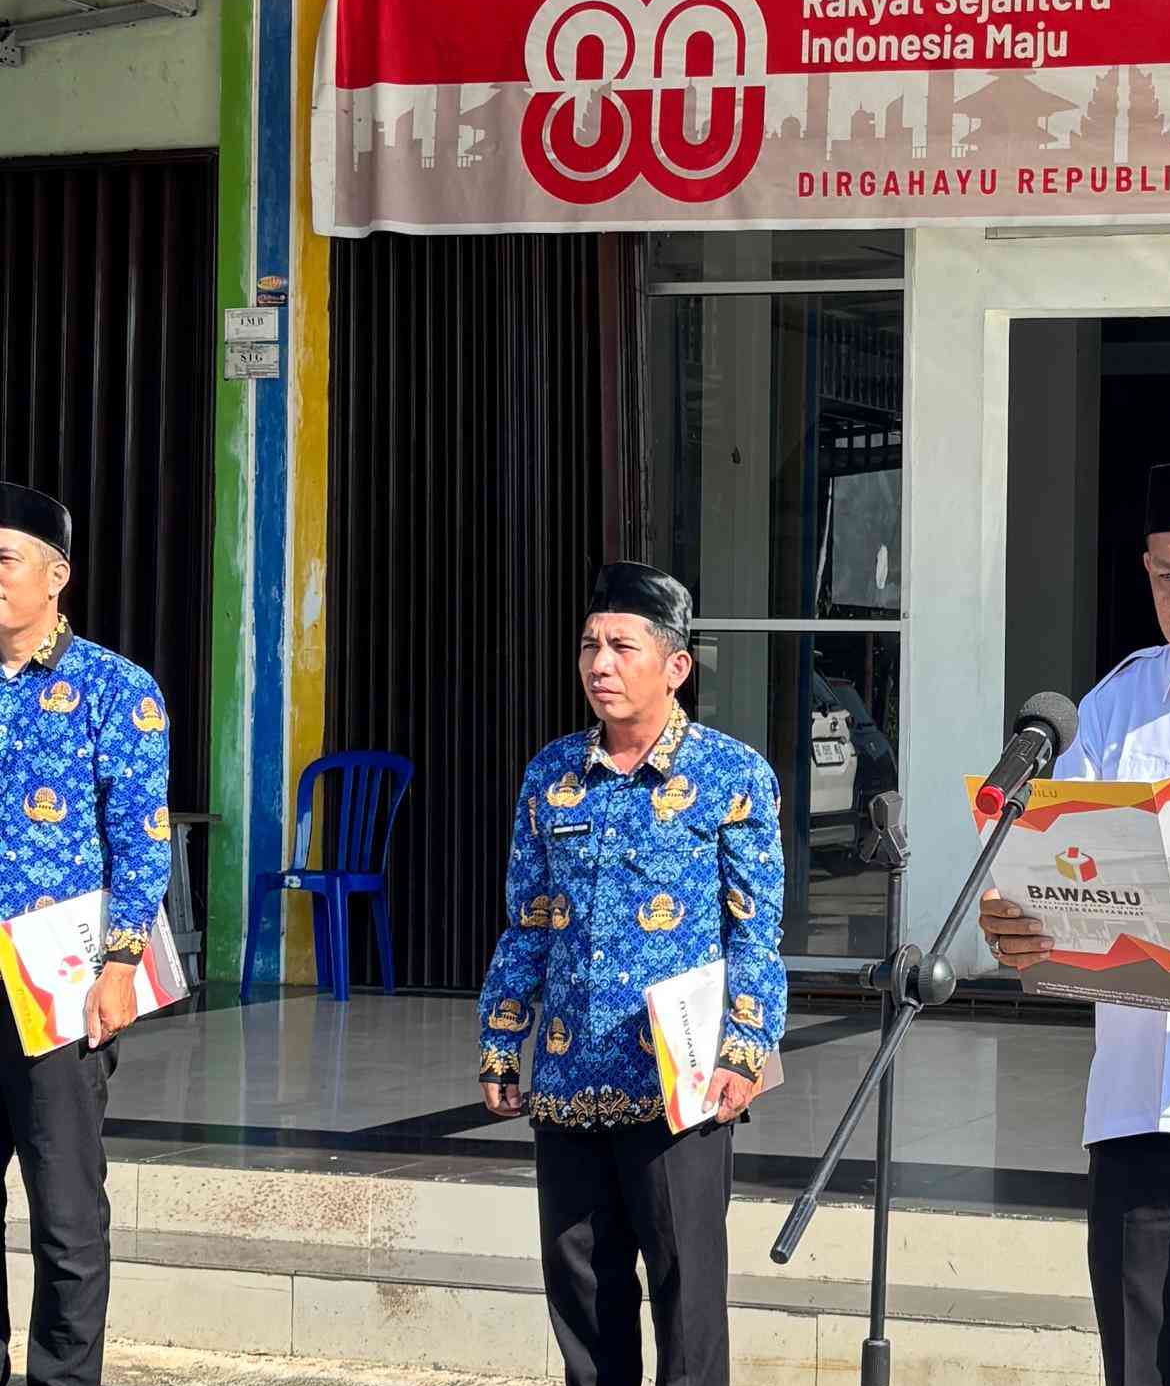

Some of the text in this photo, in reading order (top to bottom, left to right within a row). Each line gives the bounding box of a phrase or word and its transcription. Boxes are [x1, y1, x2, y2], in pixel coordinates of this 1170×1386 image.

[801, 21, 1068, 68] Indonesia Maju
[798, 169, 998, 197] DIRGAHAYU
[1027, 885, 1141, 905] BAWASLU
